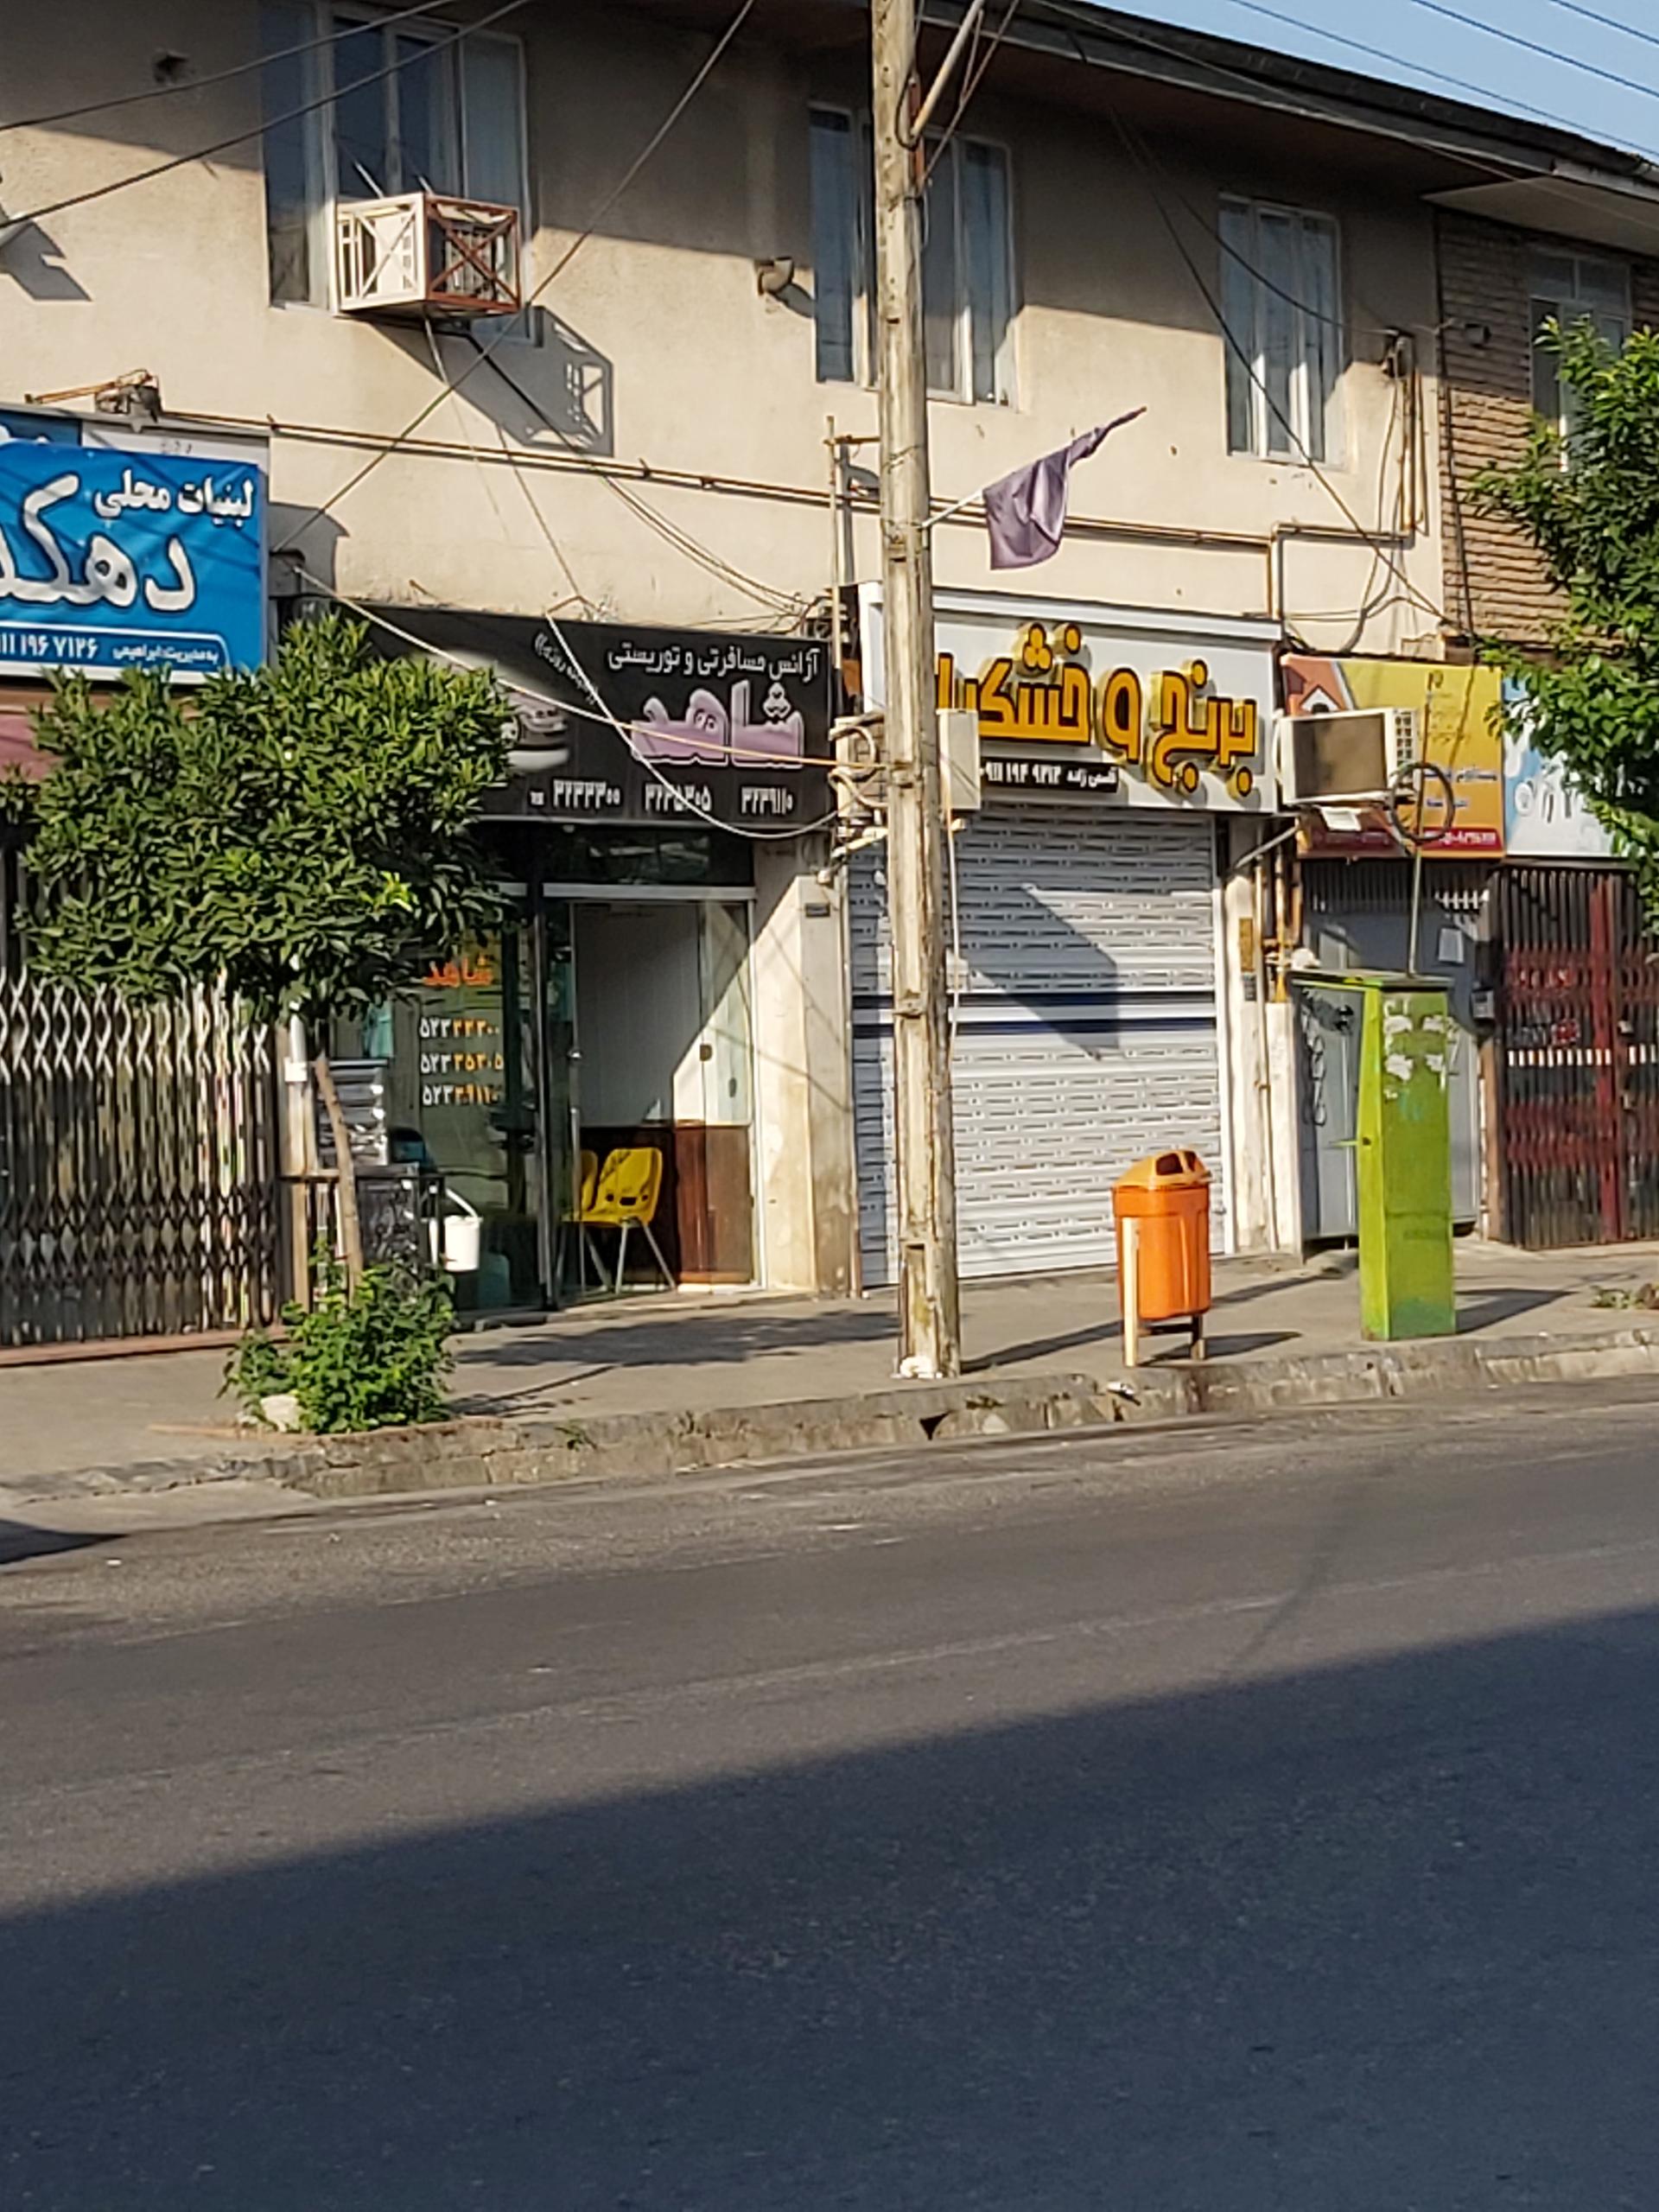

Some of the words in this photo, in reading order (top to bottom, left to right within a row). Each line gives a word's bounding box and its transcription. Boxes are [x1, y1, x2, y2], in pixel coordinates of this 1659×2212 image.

[95, 468, 171, 518] محلی
[178, 476, 253, 526] لبنیات
[607, 641, 681, 674] توریستی
[683, 651, 693, 675] و
[696, 645, 766, 677] مسافرتی
[631, 678, 806, 770] شاهد
[1101, 666, 1141, 765] و
[1149, 658, 1257, 798] برنج
[423, 953, 493, 988] شاهد
